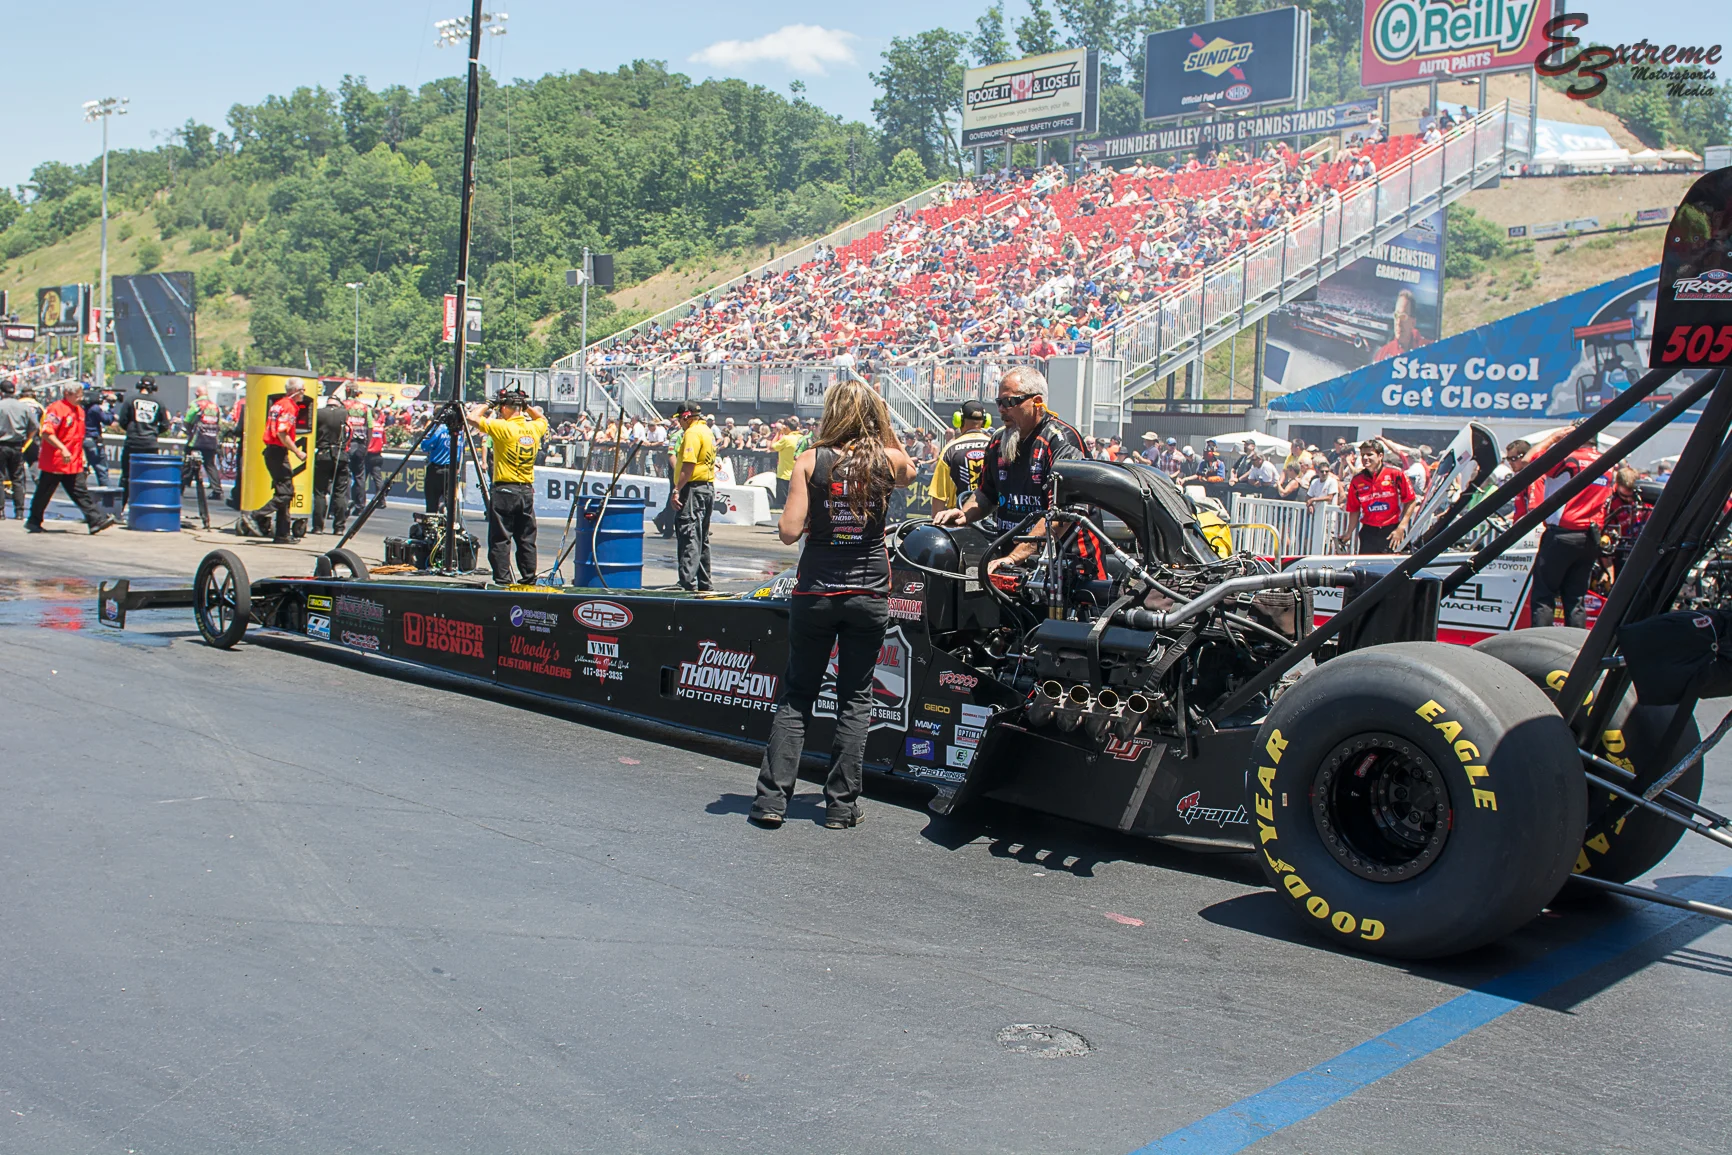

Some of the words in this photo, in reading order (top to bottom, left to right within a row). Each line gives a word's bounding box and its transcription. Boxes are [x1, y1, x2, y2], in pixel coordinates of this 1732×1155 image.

[1381, 0, 1528, 53] O'Reilly
[1186, 45, 1251, 70] SUNOCO
[1419, 58, 1450, 75] AUTO
[1452, 52, 1491, 71] PARTS
[968, 86, 999, 103] BOOZE
[1001, 84, 1011, 98] IT
[1033, 80, 1041, 92] &
[1043, 75, 1068, 91] LOSE
[1070, 73, 1080, 86] IT
[969, 128, 1004, 140] GOVERNOR'S
[1004, 126, 1030, 137] HIGHWAY
[1030, 121, 1051, 132] SAFETY
[1052, 117, 1074, 128] OFFICE
[1105, 134, 1157, 157] THUNDER
[1159, 126, 1200, 149] VALLEY
[1203, 122, 1235, 142] CLUB
[1237, 108, 1336, 139] GRANDSTANDS
[1390, 245, 1436, 270] BERNSTEIN
[1375, 263, 1420, 284] GRANDSTAND
[1661, 325, 1732, 363] 505
[1391, 356, 1458, 387] Stay
[1464, 357, 1540, 381] Cool
[1381, 384, 1434, 407] Get
[1440, 385, 1548, 410] Closer
[954, 441, 990, 451] OFFICIA
[547, 479, 657, 508] BRISTOL
[1497, 562, 1529, 571] TOYOTA
[308, 628, 330, 638] CARRILLO
[425, 615, 484, 641] FISCHER
[426, 632, 485, 659] HONDA
[510, 635, 560, 666] Woody's
[591, 642, 615, 656] VMW
[498, 655, 532, 671] CUSTOM
[532, 662, 572, 679] HEADERS
[698, 641, 754, 681] Tommy
[679, 662, 777, 699] THOMPSON
[676, 687, 779, 713] MOTORSPORTS
[817, 699, 835, 710] DRAG
[924, 703, 951, 714] GEICO
[878, 709, 902, 721] SERIES
[958, 729, 981, 740] OPTIMA
[1414, 699, 1498, 812] EAGLE
[1255, 728, 1386, 941] GOODYEAR
